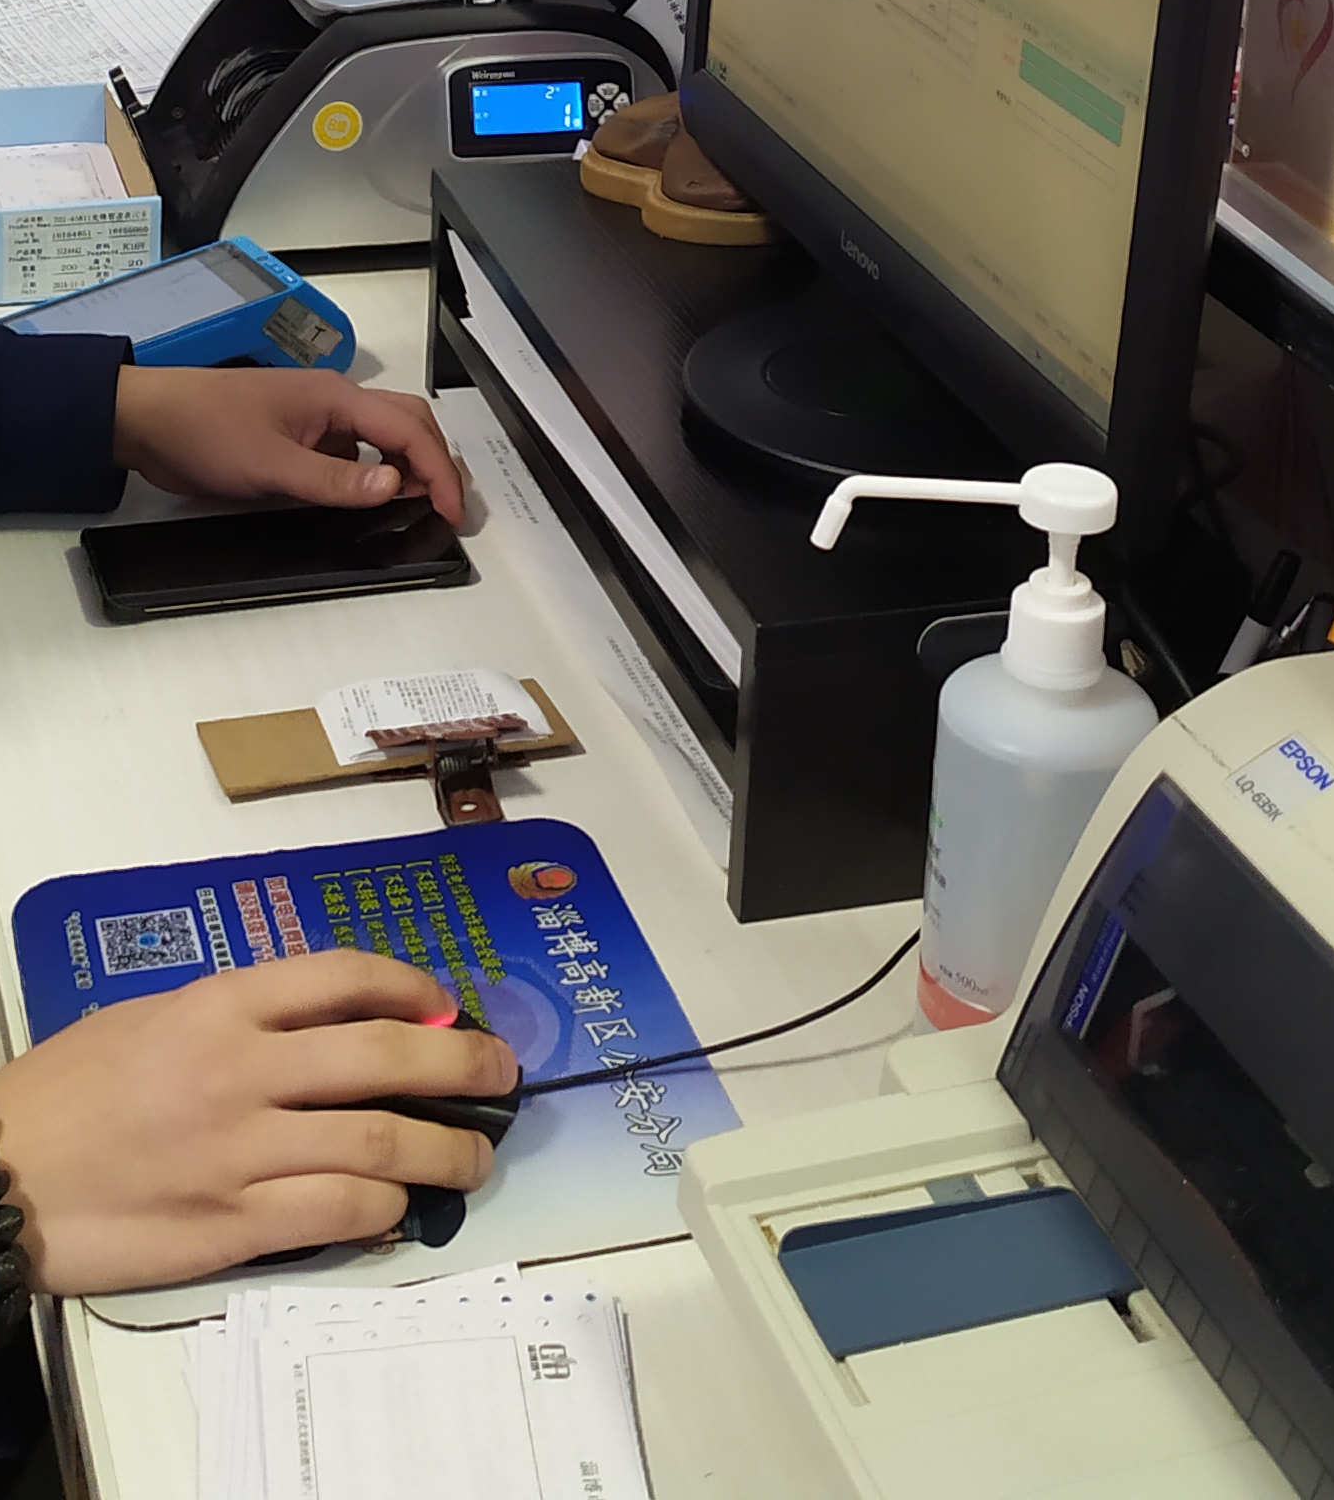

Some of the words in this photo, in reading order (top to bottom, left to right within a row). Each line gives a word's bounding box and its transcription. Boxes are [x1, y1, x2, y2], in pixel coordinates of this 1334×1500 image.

[840, 229, 880, 281] Lenovo
[1234, 773, 1284, 822] LQ-635K
[531, 902, 686, 1177] 淄博高新区公安分局
